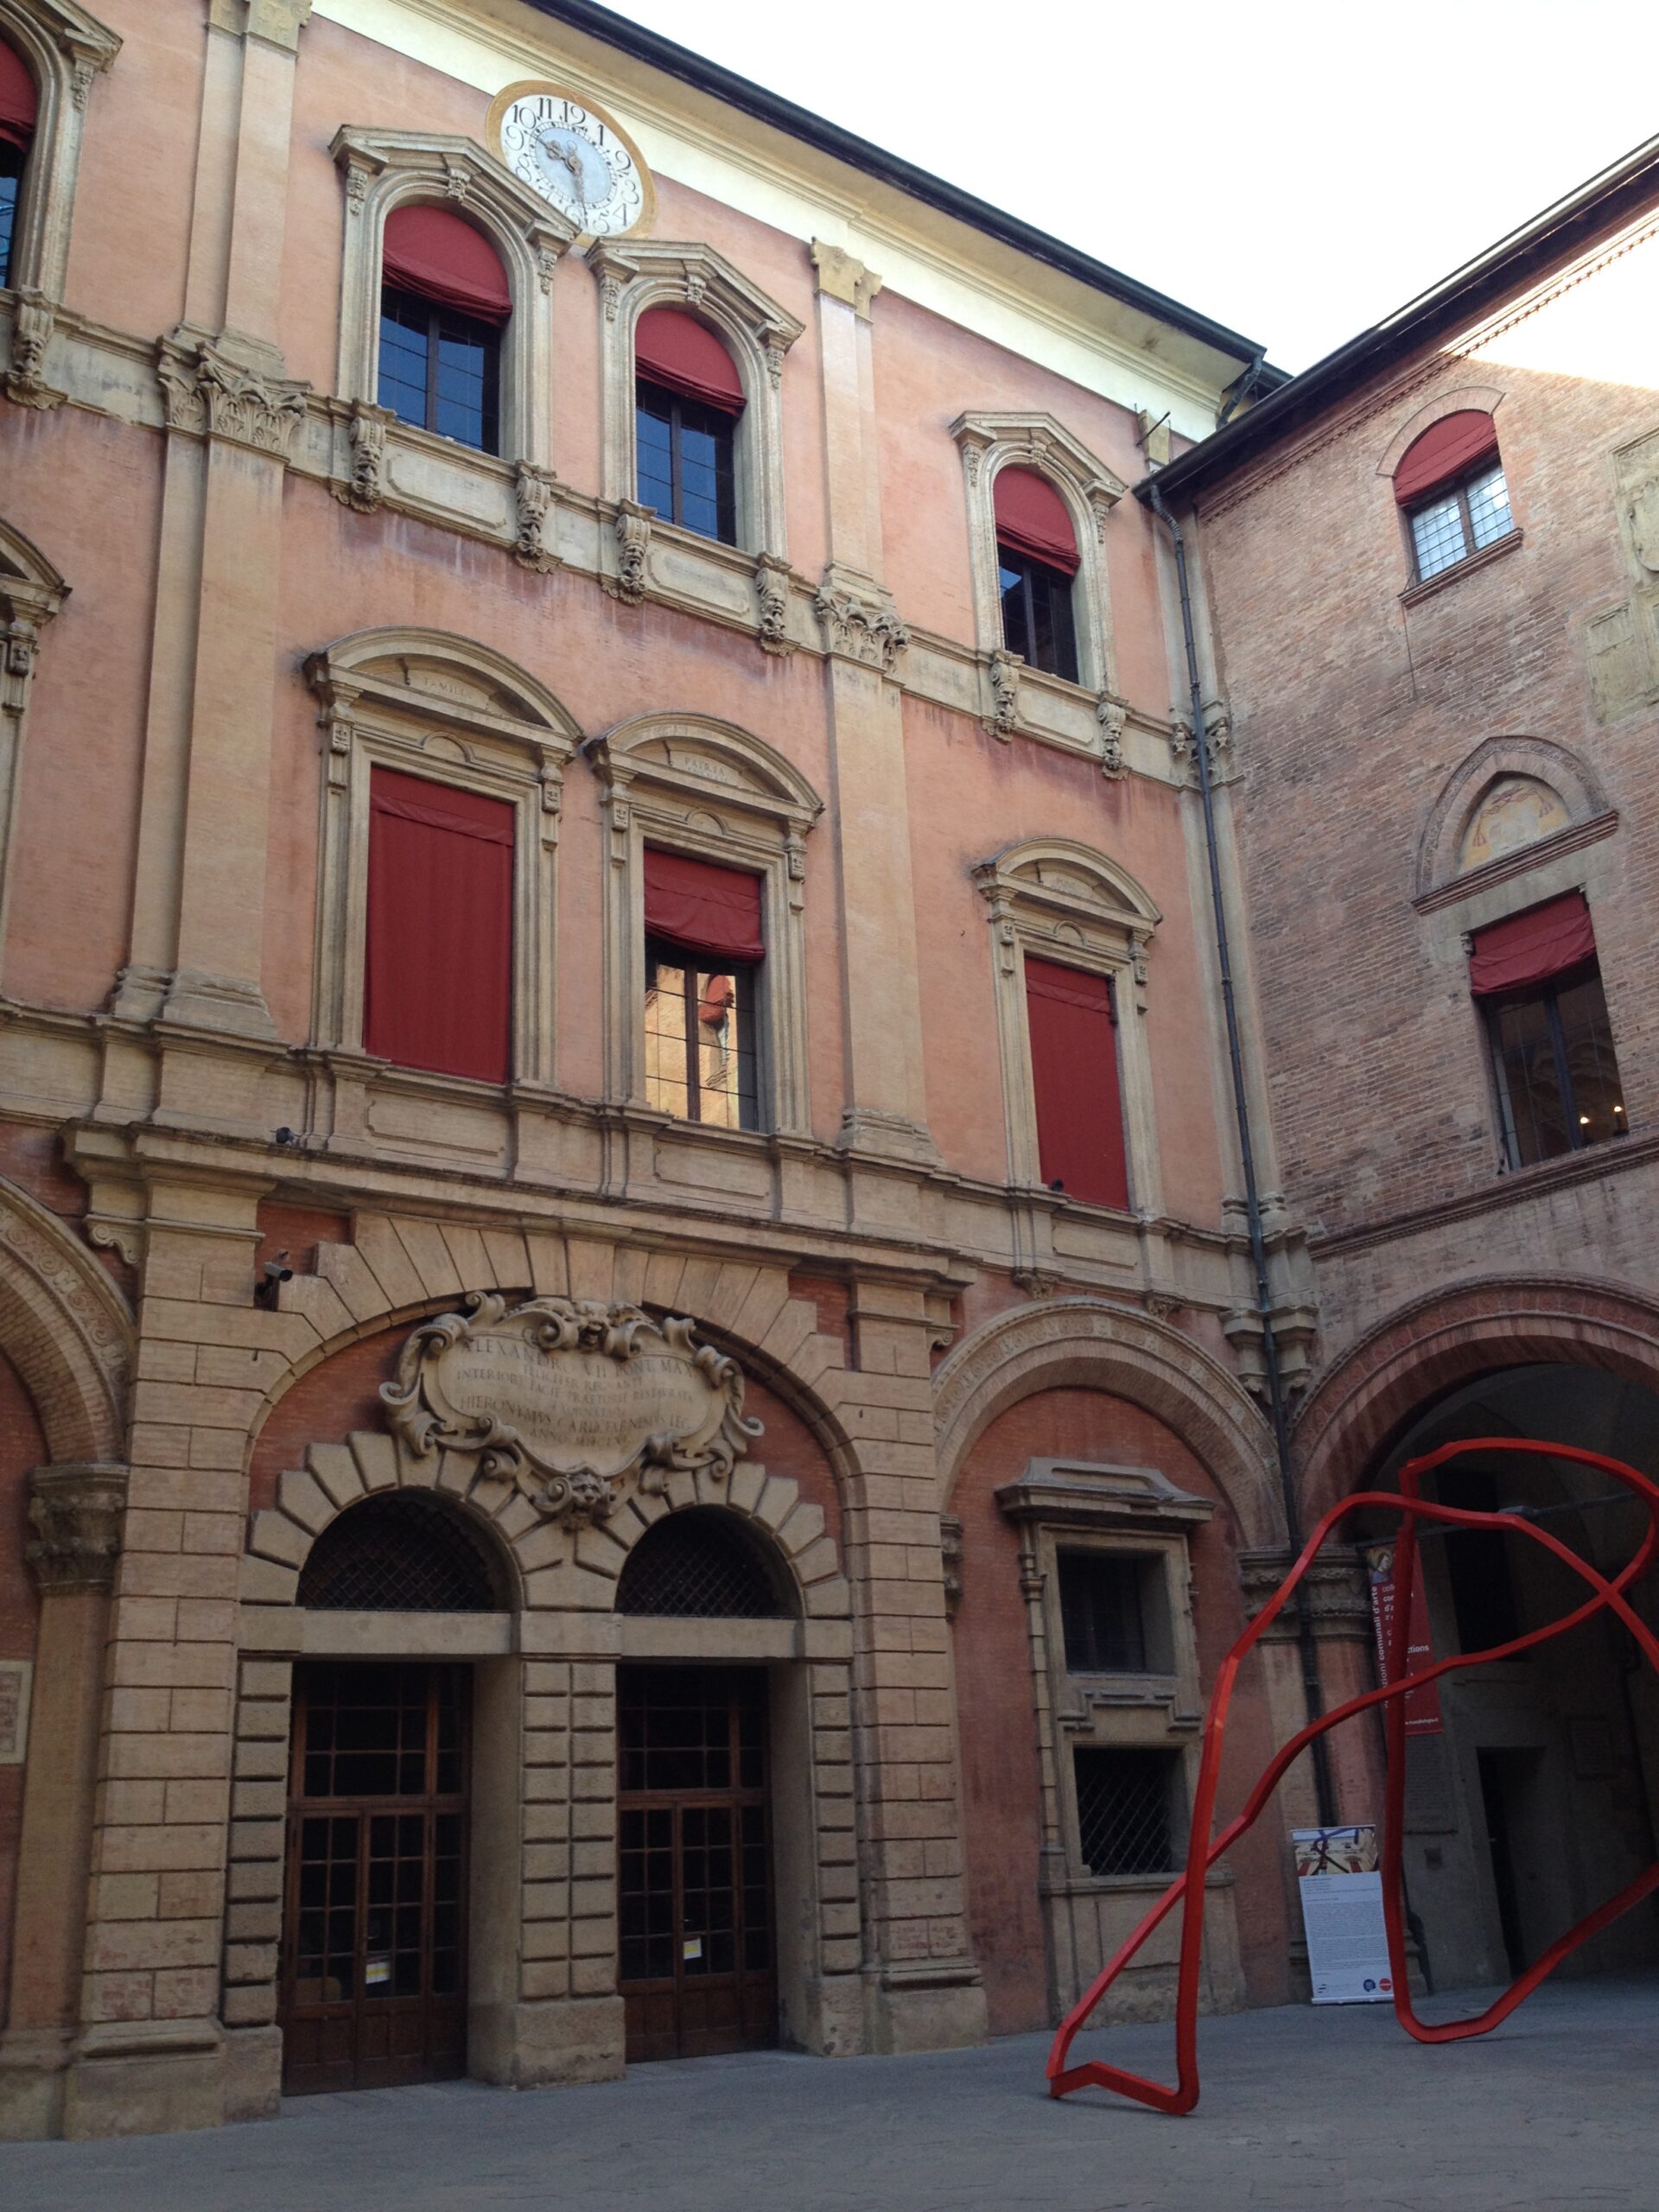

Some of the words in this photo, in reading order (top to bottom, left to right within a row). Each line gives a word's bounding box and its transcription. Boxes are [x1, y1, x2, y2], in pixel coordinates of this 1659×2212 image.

[512, 104, 537, 129] 10
[537, 97, 552, 120] 11
[562, 101, 587, 130] 12
[505, 125, 525, 151] 9
[597, 124, 605, 146] 1
[614, 149, 631, 176] 2
[620, 179, 640, 205] 3
[593, 209, 610, 235] 5
[612, 202, 628, 227] 4
[1373, 1616, 1386, 1662] comunali
